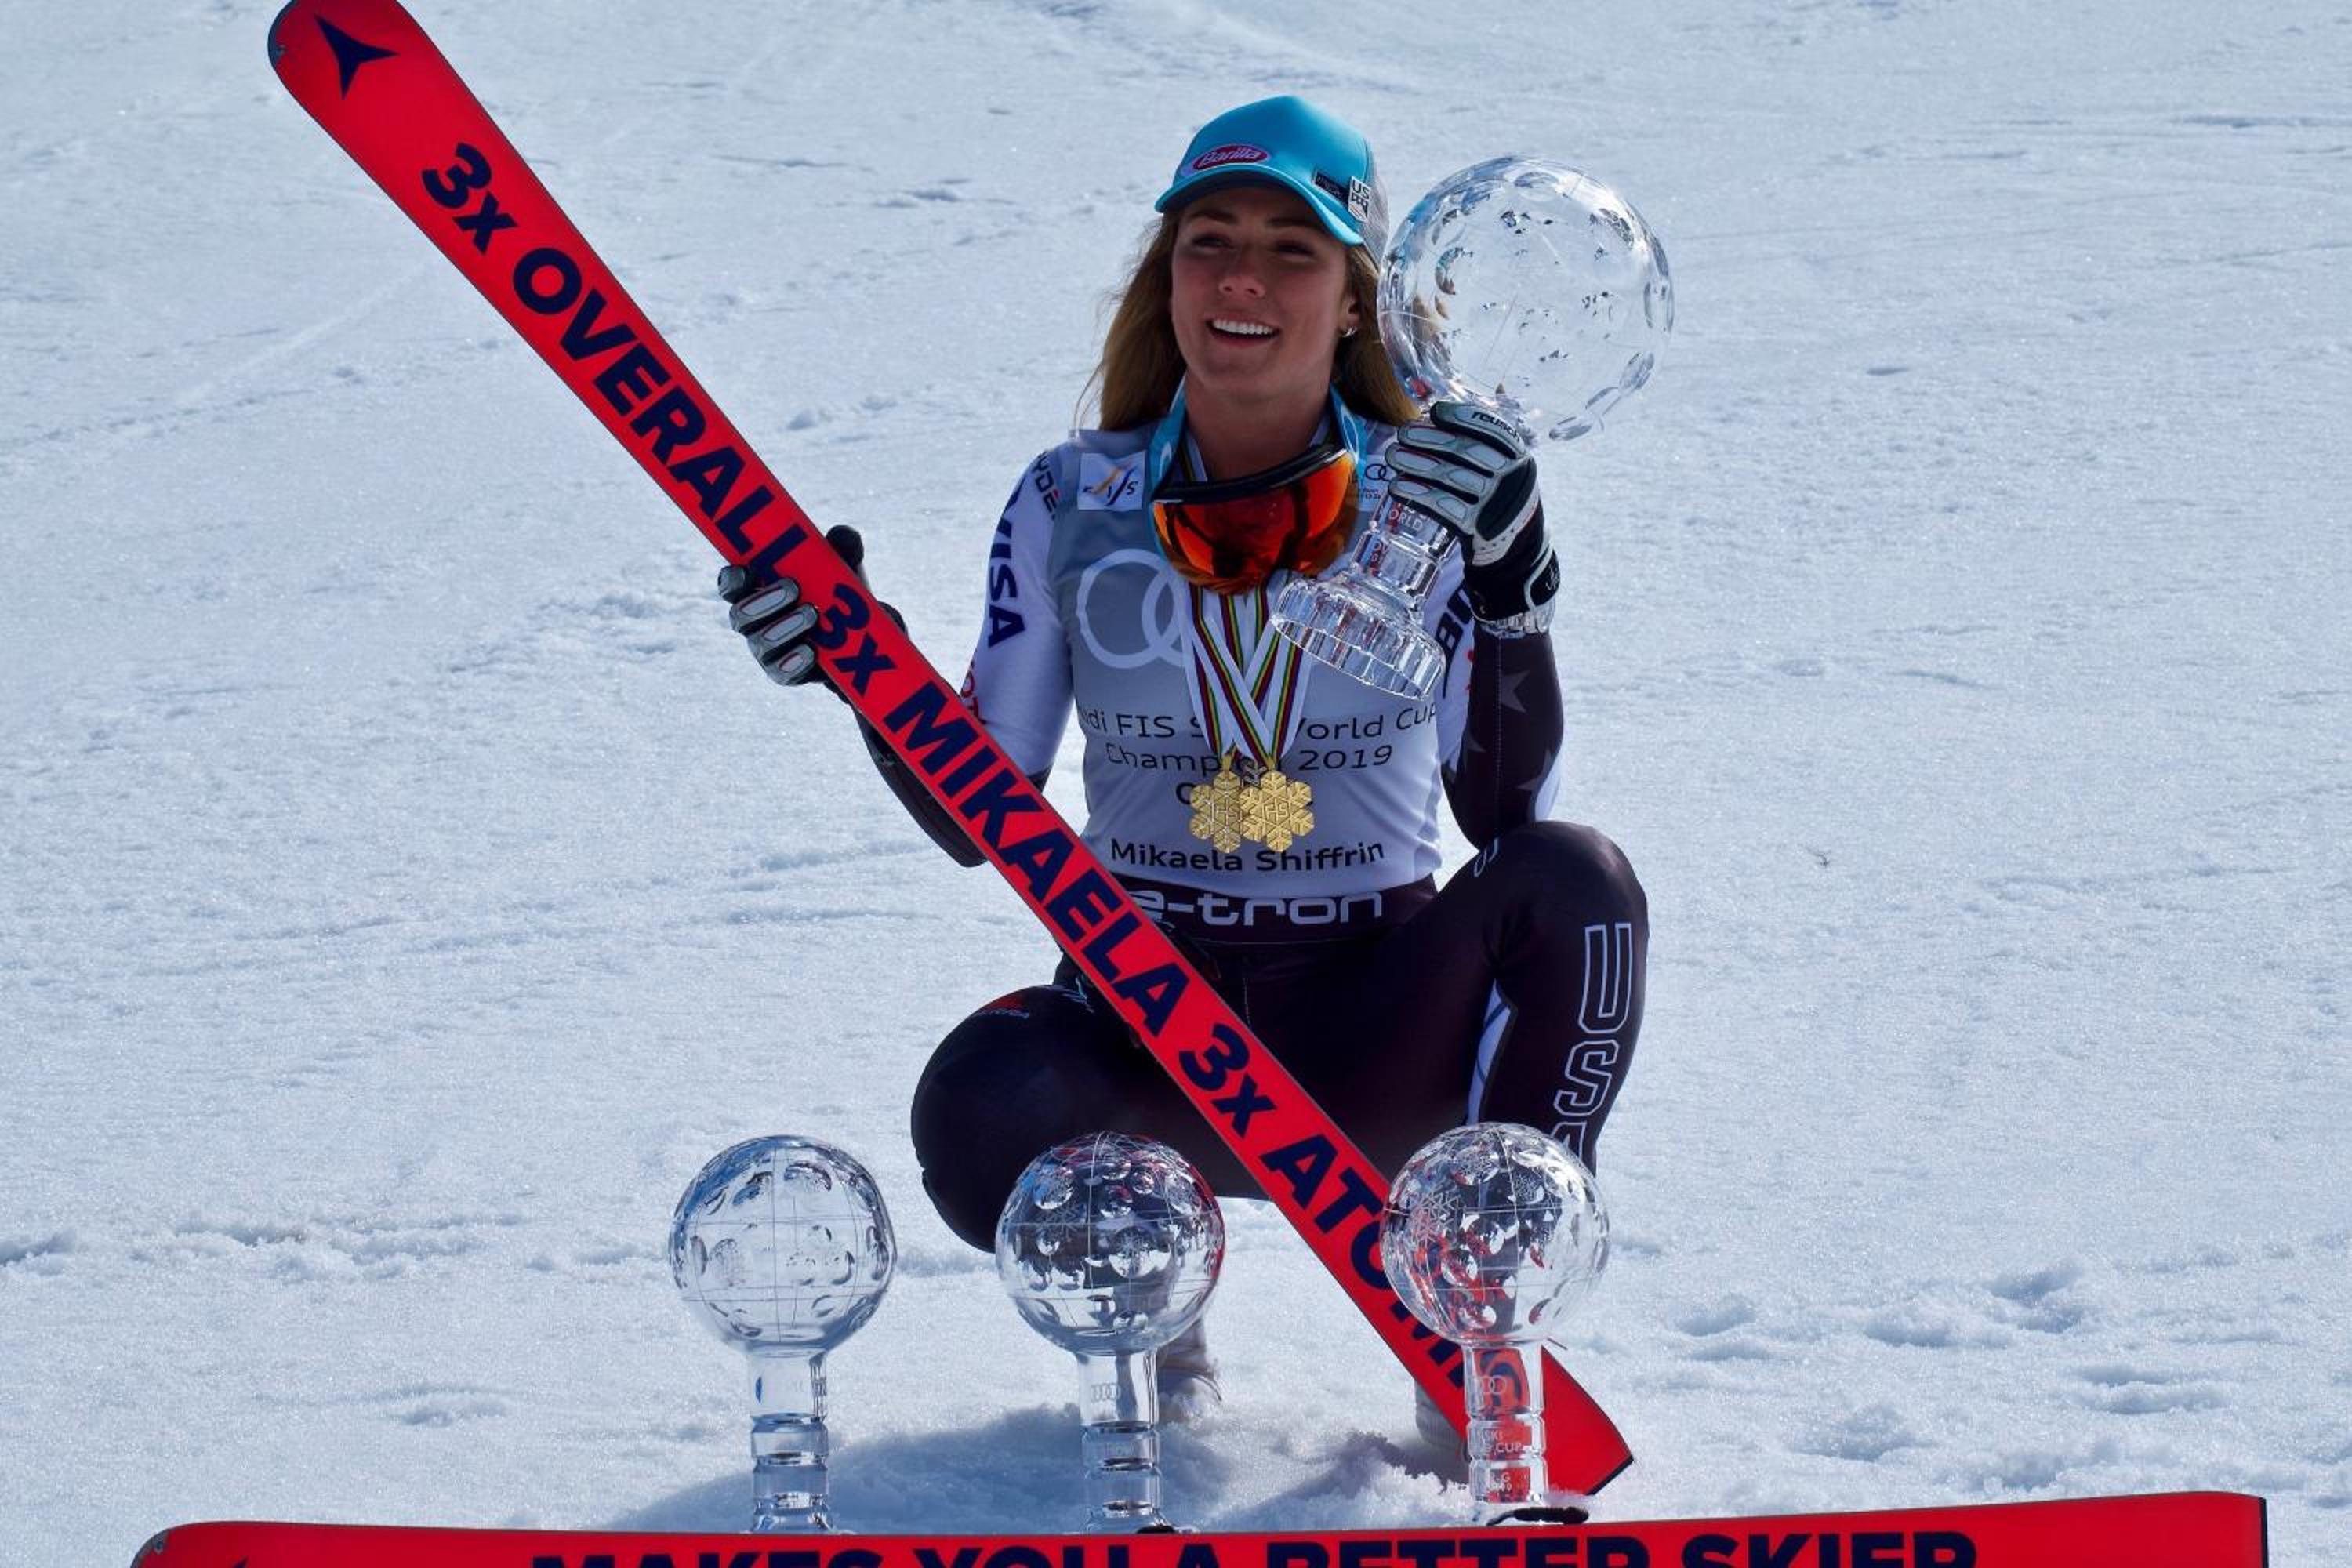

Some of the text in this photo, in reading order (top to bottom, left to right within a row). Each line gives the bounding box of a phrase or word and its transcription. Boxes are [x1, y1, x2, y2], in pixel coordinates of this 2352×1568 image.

[1388, 509, 1423, 532] ORLD
[422, 143, 517, 254] 3x
[513, 247, 808, 584] OVERALL
[814, 583, 896, 696] 3x
[883, 681, 1189, 1036] MIKAELA
[1179, 1024, 1276, 1138] 3x
[1116, 713, 1175, 738] FIS
[1298, 745, 1392, 771] 2019
[1111, 838, 1385, 872] Mikaela Shiffrin
